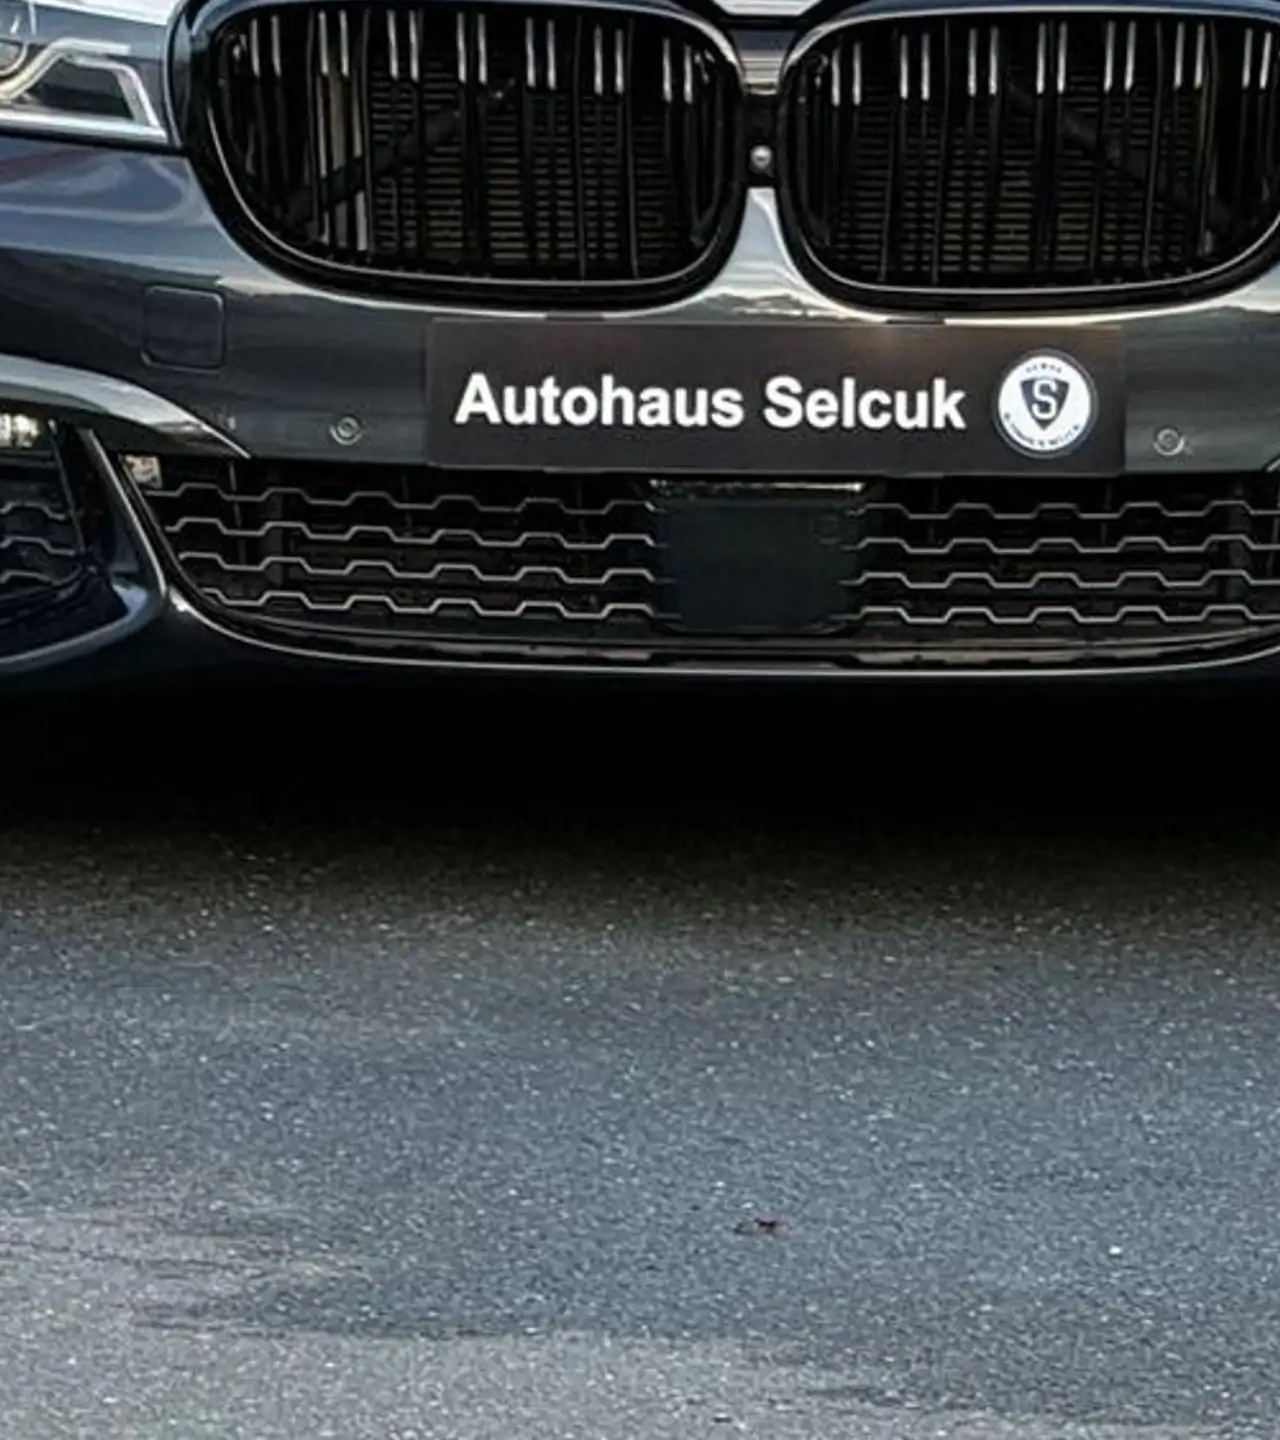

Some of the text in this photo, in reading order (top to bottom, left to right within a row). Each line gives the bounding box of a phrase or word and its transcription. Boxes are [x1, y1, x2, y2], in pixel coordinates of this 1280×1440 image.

[454, 372, 745, 428] Autohaus
[762, 374, 967, 430] Selcuk
[1031, 378, 1059, 421] S
